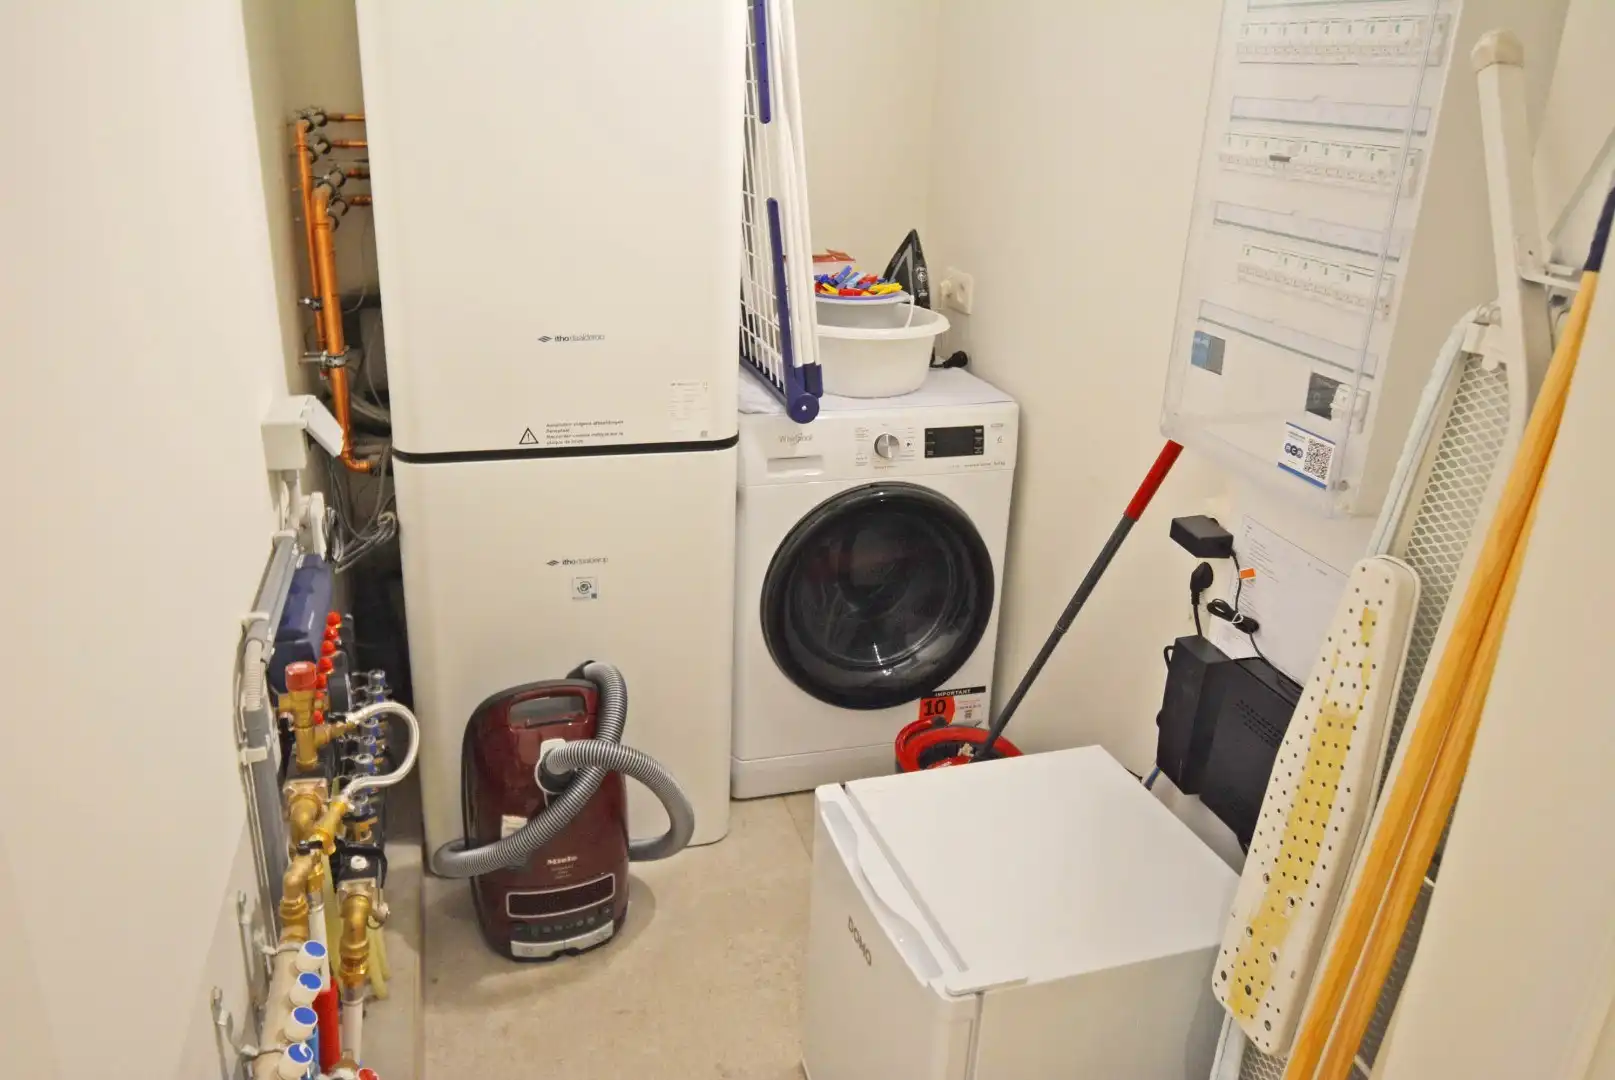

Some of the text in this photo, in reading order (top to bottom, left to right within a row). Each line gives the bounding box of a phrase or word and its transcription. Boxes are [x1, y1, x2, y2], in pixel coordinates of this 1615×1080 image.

[935, 689, 972, 697] IMPORTANT
[923, 699, 947, 717] 10
[547, 855, 578, 865] Miele
[848, 914, 872, 967] DOMO
